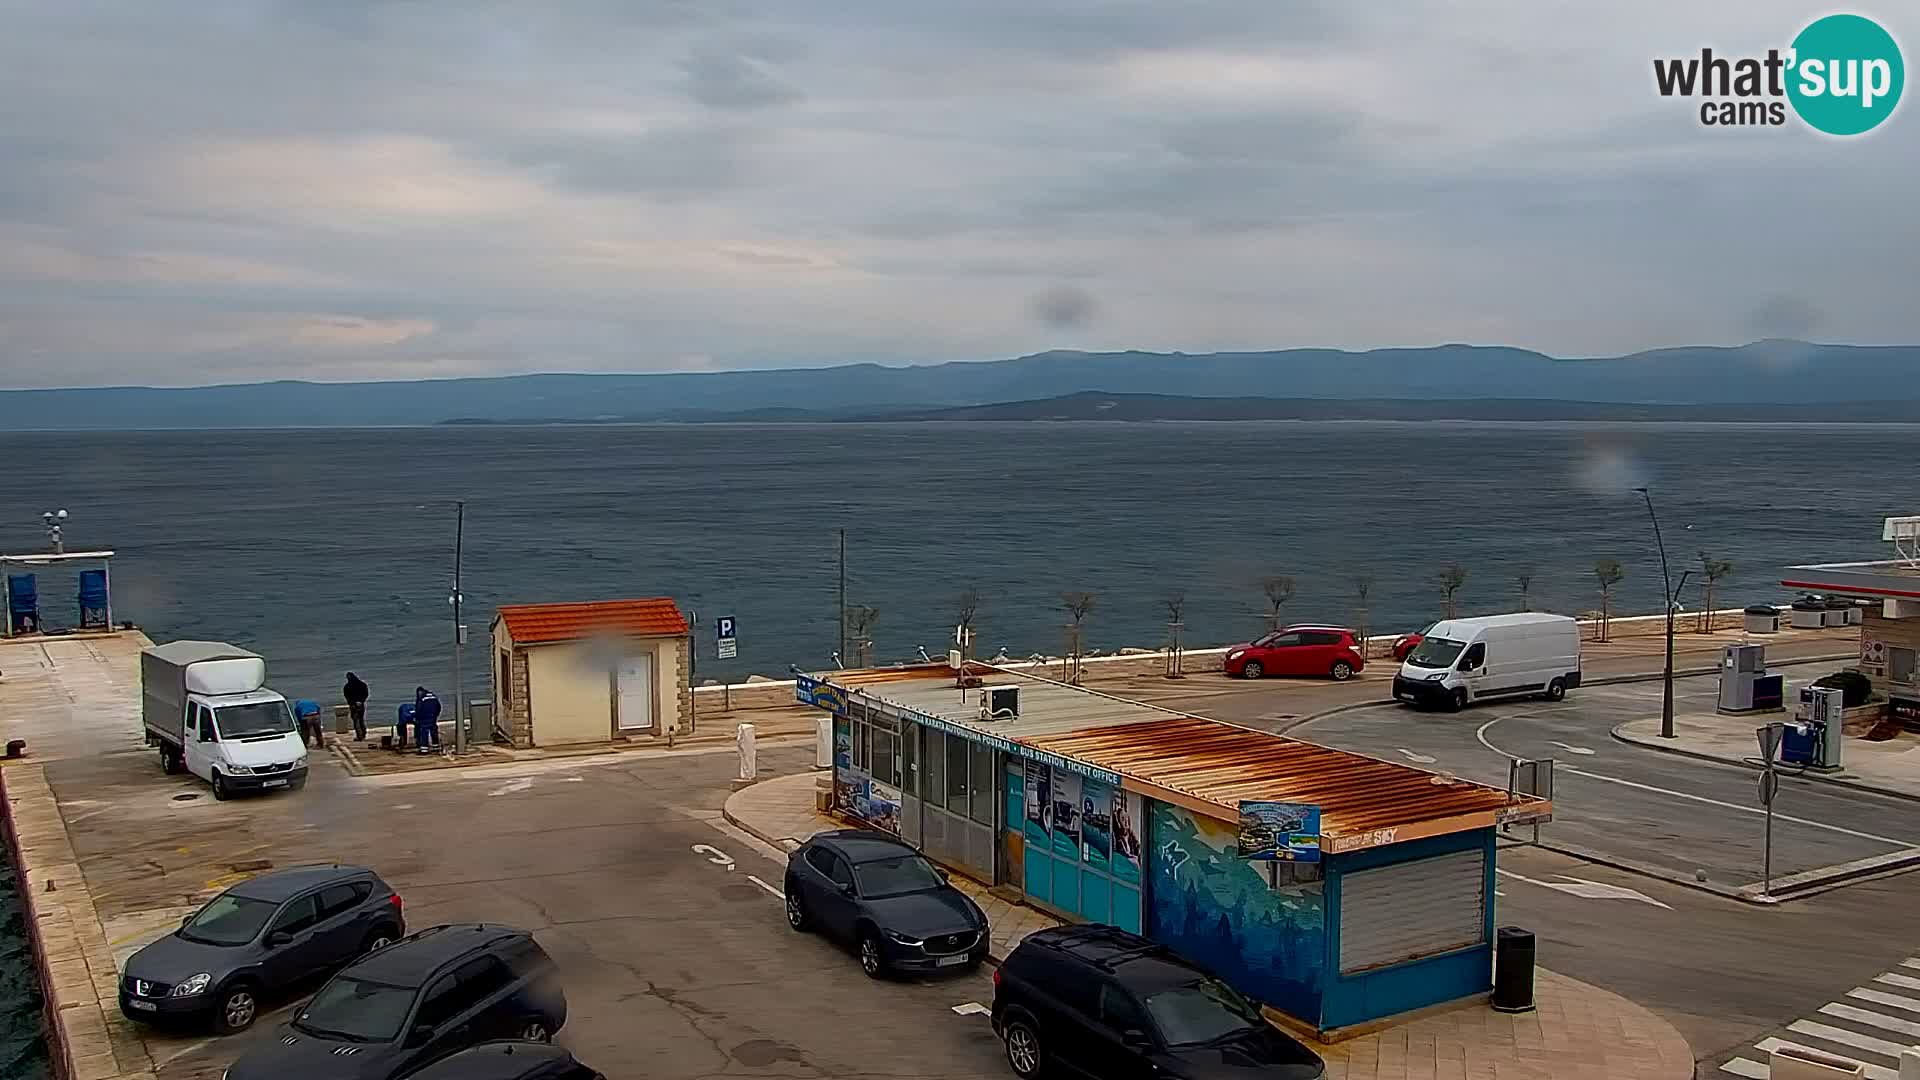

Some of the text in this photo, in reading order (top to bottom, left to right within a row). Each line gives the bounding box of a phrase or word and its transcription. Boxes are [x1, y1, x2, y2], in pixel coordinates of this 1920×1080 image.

[721, 619, 732, 636] P
[982, 735, 1011, 752] POSTAJA
[1020, 746, 1034, 758] BUS
[1035, 750, 1065, 768] STATION
[1066, 760, 1091, 776] TICKET
[1093, 769, 1118, 784] OFFICE
